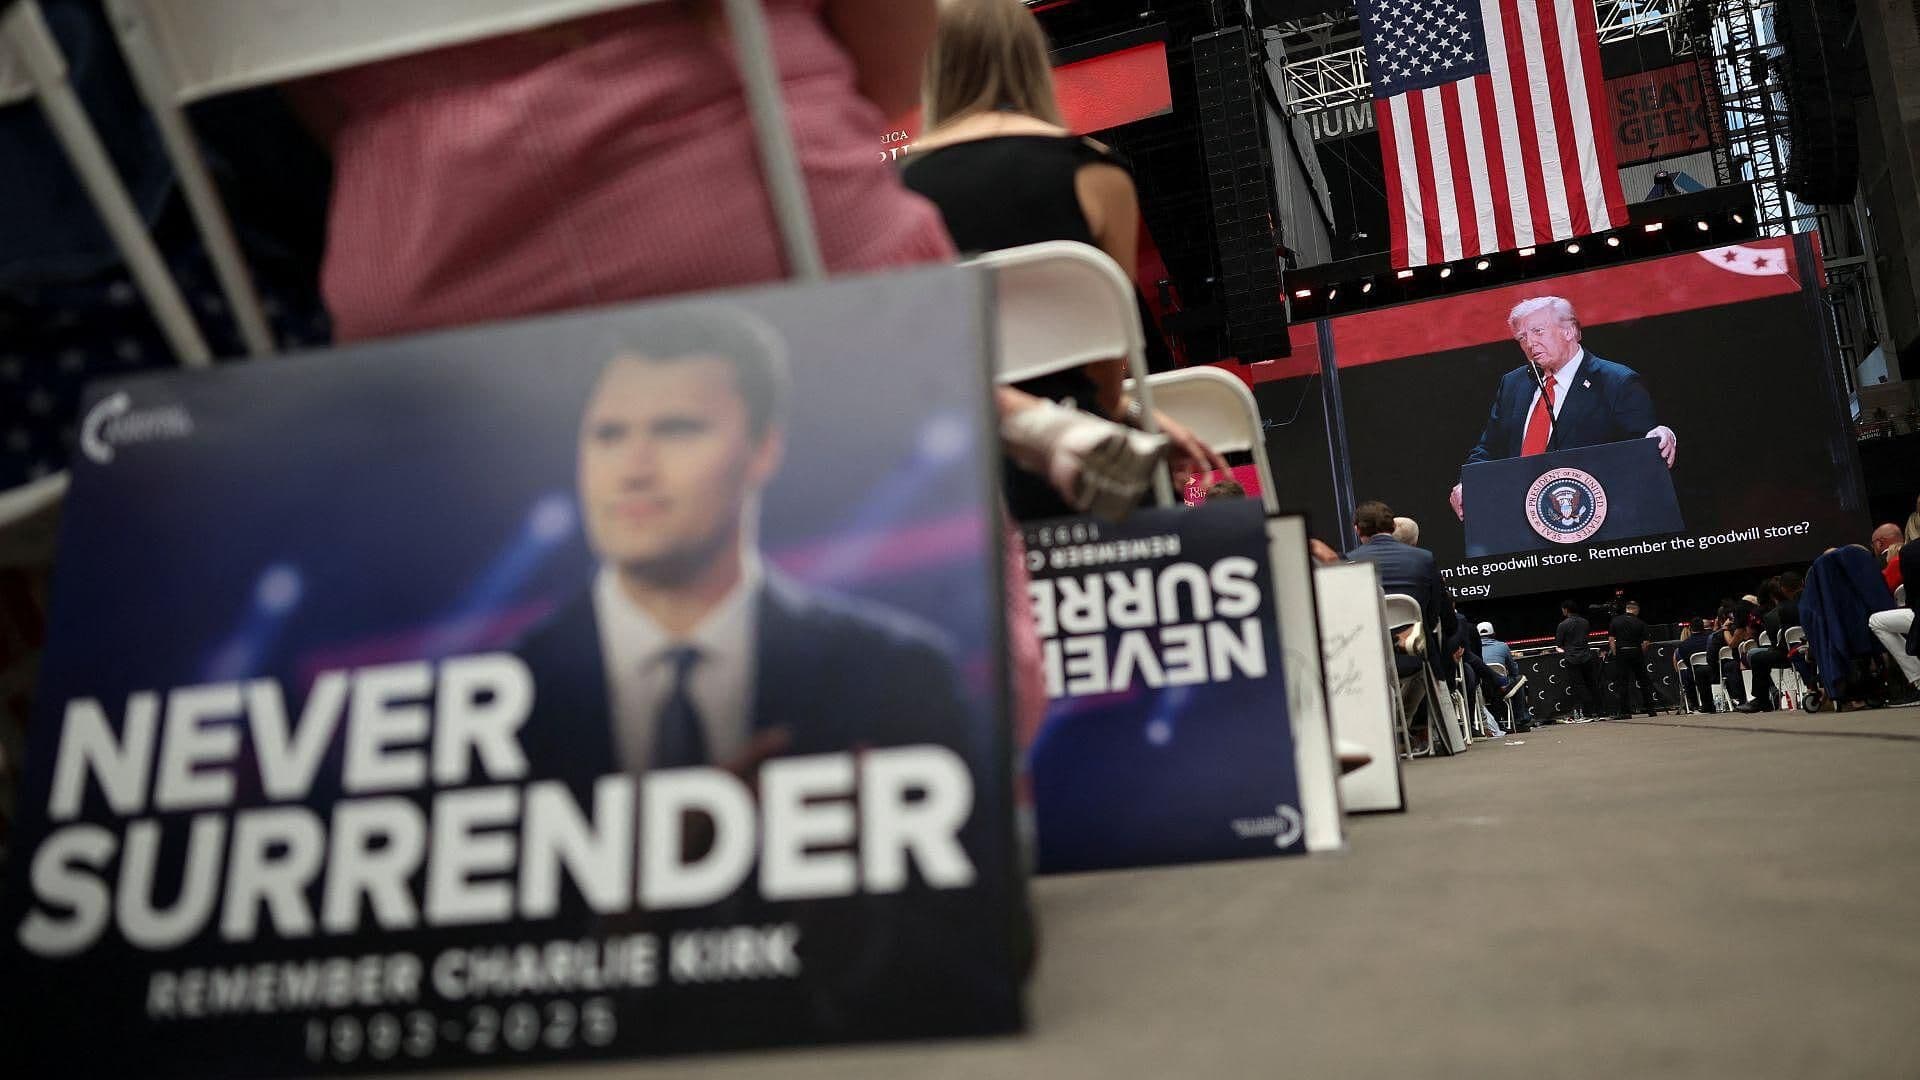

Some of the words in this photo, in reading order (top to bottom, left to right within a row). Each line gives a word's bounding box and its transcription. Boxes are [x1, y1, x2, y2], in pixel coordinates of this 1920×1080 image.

[1617, 74, 1699, 116] SEAT
[1617, 103, 1707, 145] GEEK
[1528, 471, 1561, 507] PRESIDENT
[1584, 477, 1604, 508] UNITED
[1577, 514, 1602, 539] STATES
[1456, 564, 1479, 577] the
[1482, 555, 1539, 576] goodwill
[1541, 552, 1582, 566] store.
[1588, 540, 1667, 561] Remember
[1670, 536, 1695, 551] the
[1698, 527, 1760, 550] goodwill
[1763, 521, 1810, 538] store?
[1460, 583, 1491, 598] easy
[48, 652, 535, 820] NEVER
[17, 743, 977, 955] SURRENDER
[146, 953, 421, 1020] REMEMBER
[431, 934, 657, 1001] CHARLIE
[667, 923, 804, 983] KIRK
